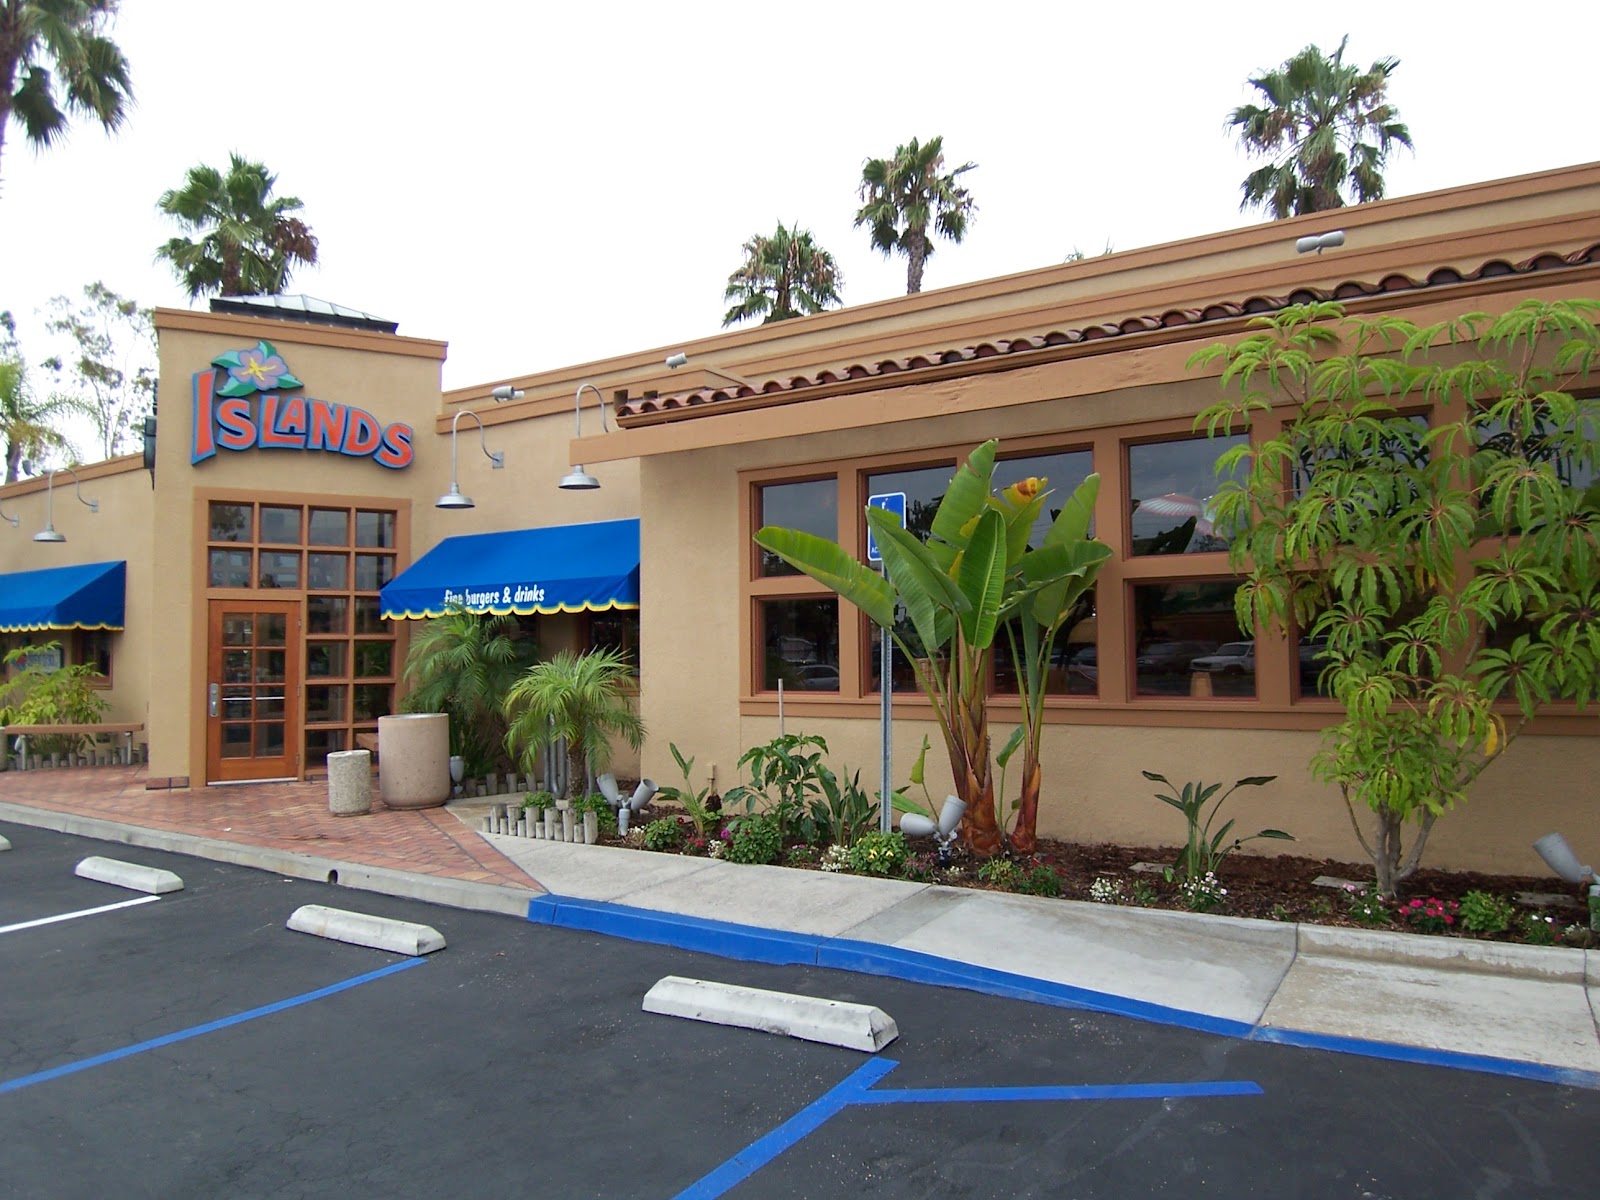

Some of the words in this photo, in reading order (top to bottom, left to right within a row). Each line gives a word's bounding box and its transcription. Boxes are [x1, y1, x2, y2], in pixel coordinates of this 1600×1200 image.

[191, 368, 414, 469] ISLANDS
[444, 589, 464, 607] fine
[465, 588, 500, 610] burgers
[502, 586, 511, 604] &
[514, 584, 545, 603] drinks
